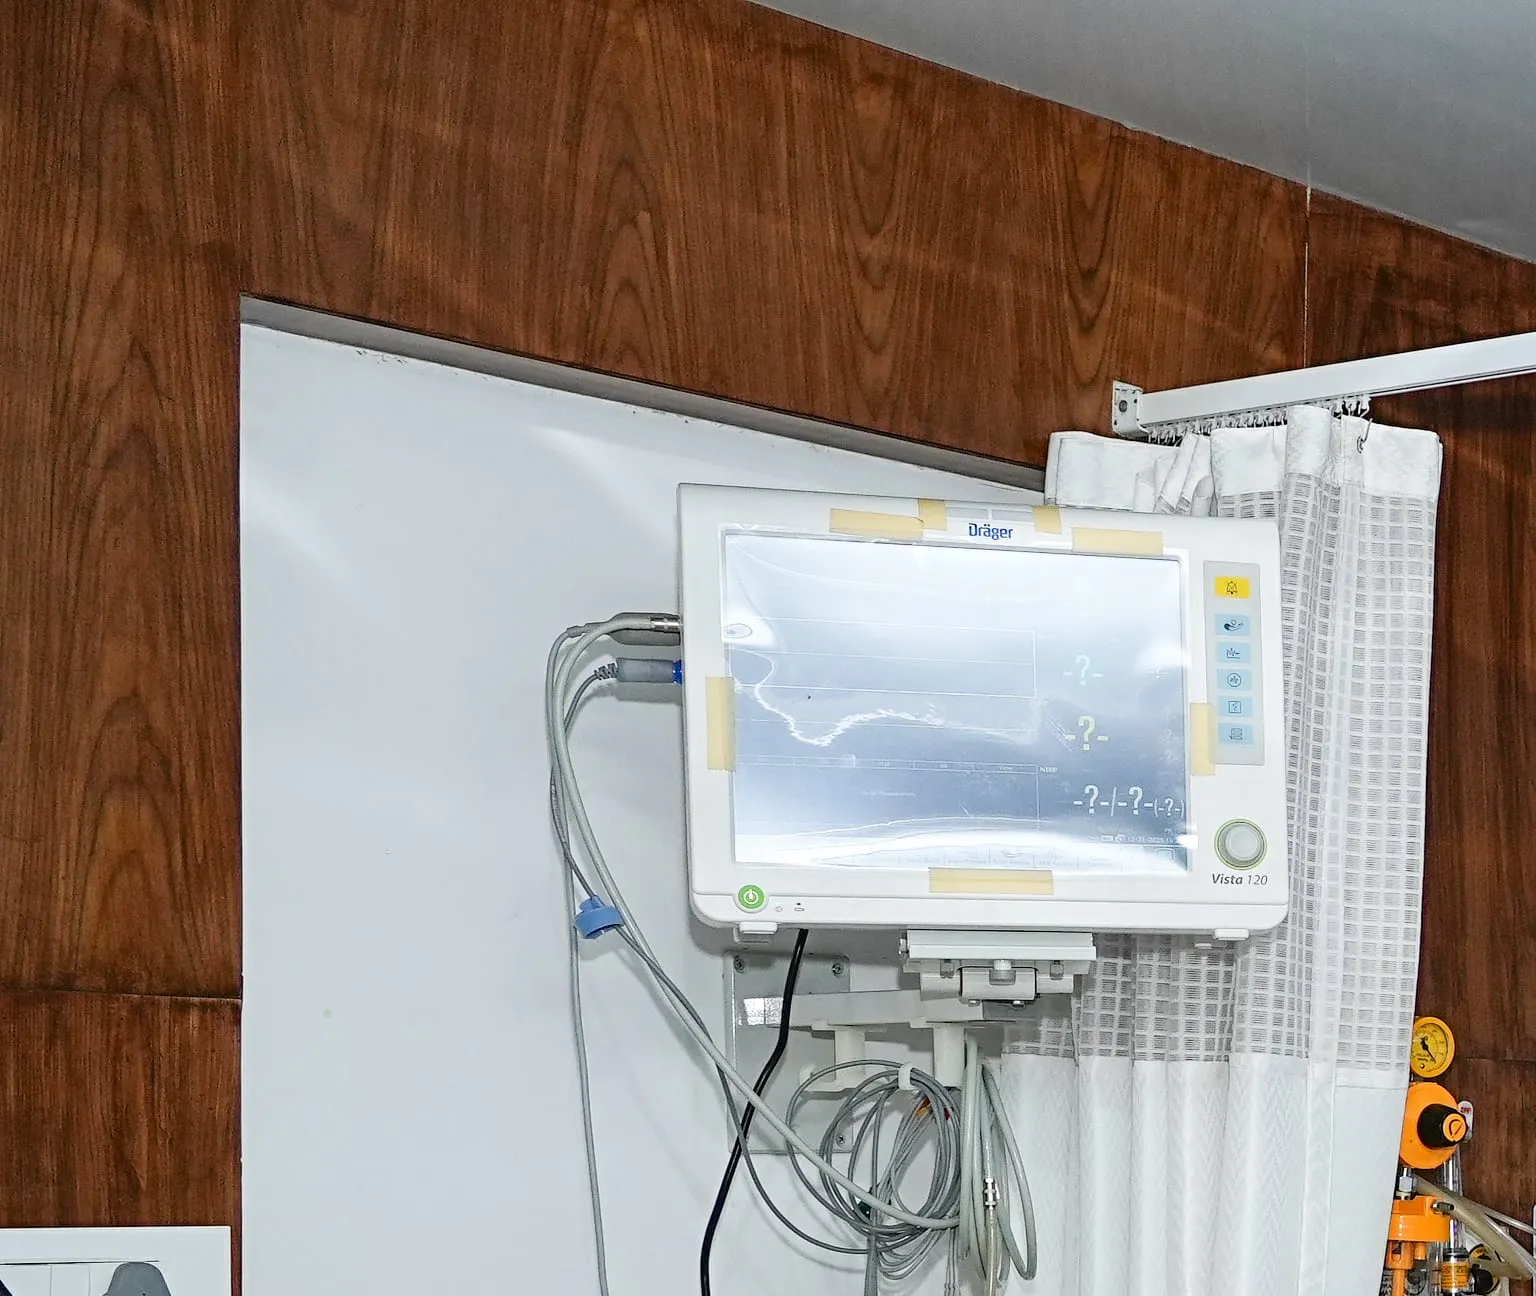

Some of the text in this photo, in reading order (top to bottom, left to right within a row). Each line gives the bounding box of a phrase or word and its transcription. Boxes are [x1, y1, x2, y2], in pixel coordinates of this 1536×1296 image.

[968, 522, 1014, 541] Dräger
[1212, 873, 1268, 886] Vista 120
